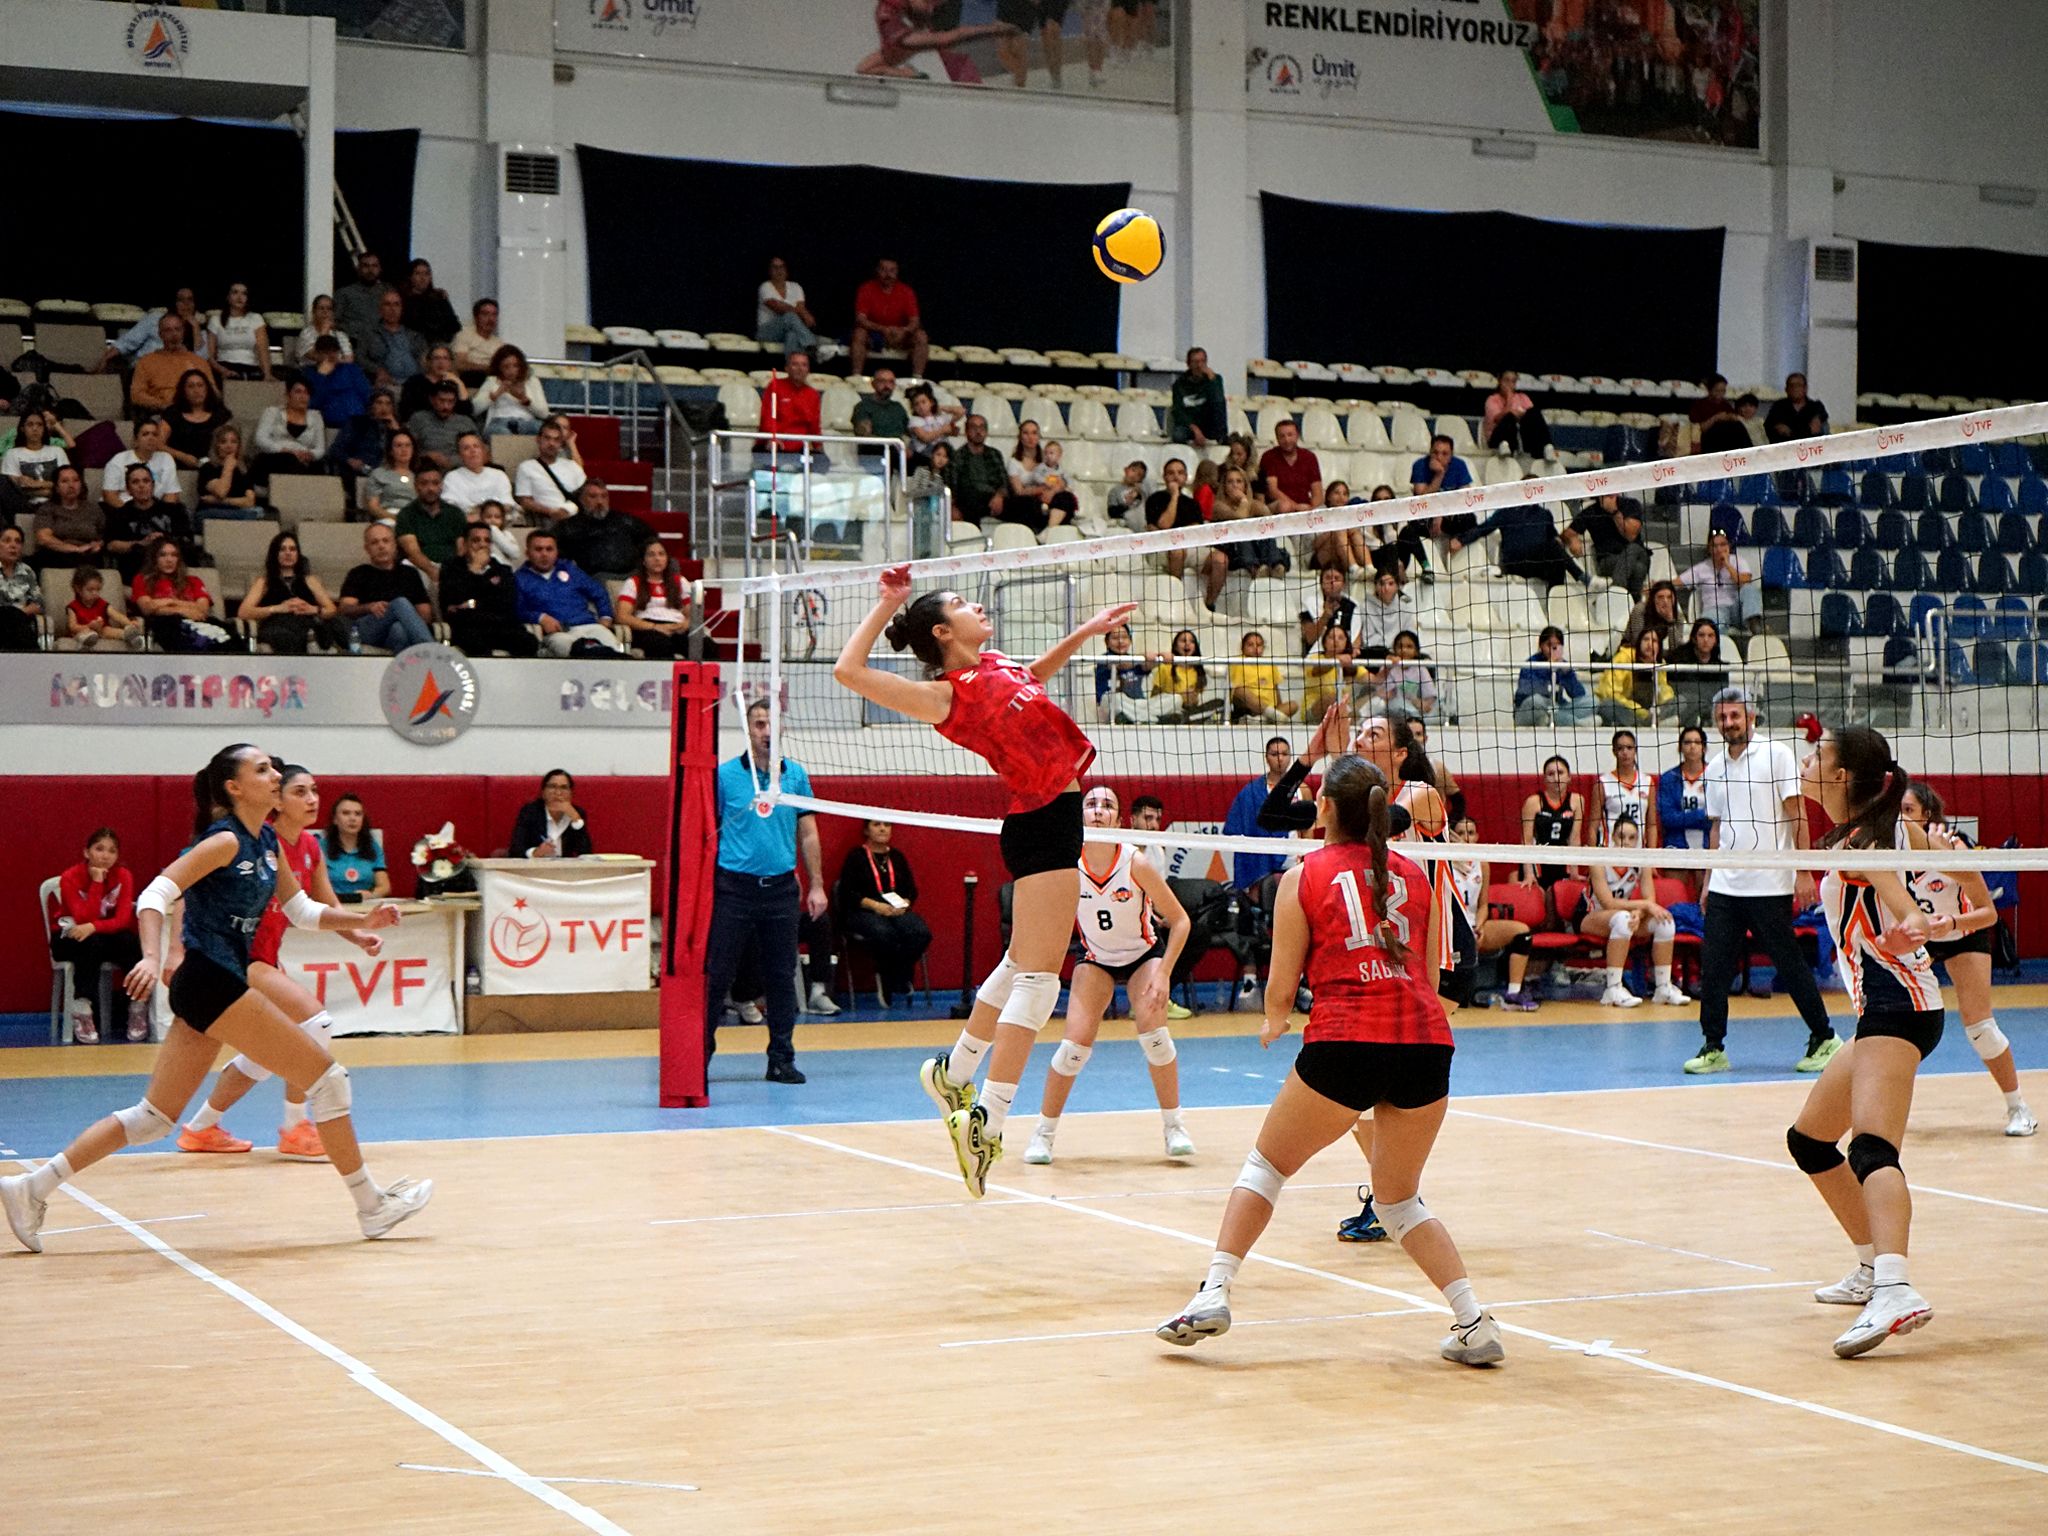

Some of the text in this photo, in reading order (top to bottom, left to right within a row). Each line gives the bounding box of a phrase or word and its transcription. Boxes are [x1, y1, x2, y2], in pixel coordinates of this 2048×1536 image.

[1265, 2, 1529, 47] RENKLENDİRİYORUZ
[1311, 53, 1356, 79] Ümit
[1888, 433, 1905, 444] TVF
[1808, 445, 1824, 456] TVF
[1732, 456, 1747, 467] TVF
[1595, 476, 1608, 487] TVF
[1662, 467, 1676, 477] TVF
[1532, 485, 1545, 496] TVF
[50, 673, 308, 718] MURATPAŞA
[1551, 822, 1562, 840] 2
[1096, 909, 1114, 931] 8
[1331, 869, 1410, 951] 13
[560, 919, 645, 953] TVF
[303, 959, 428, 1007] TVF
